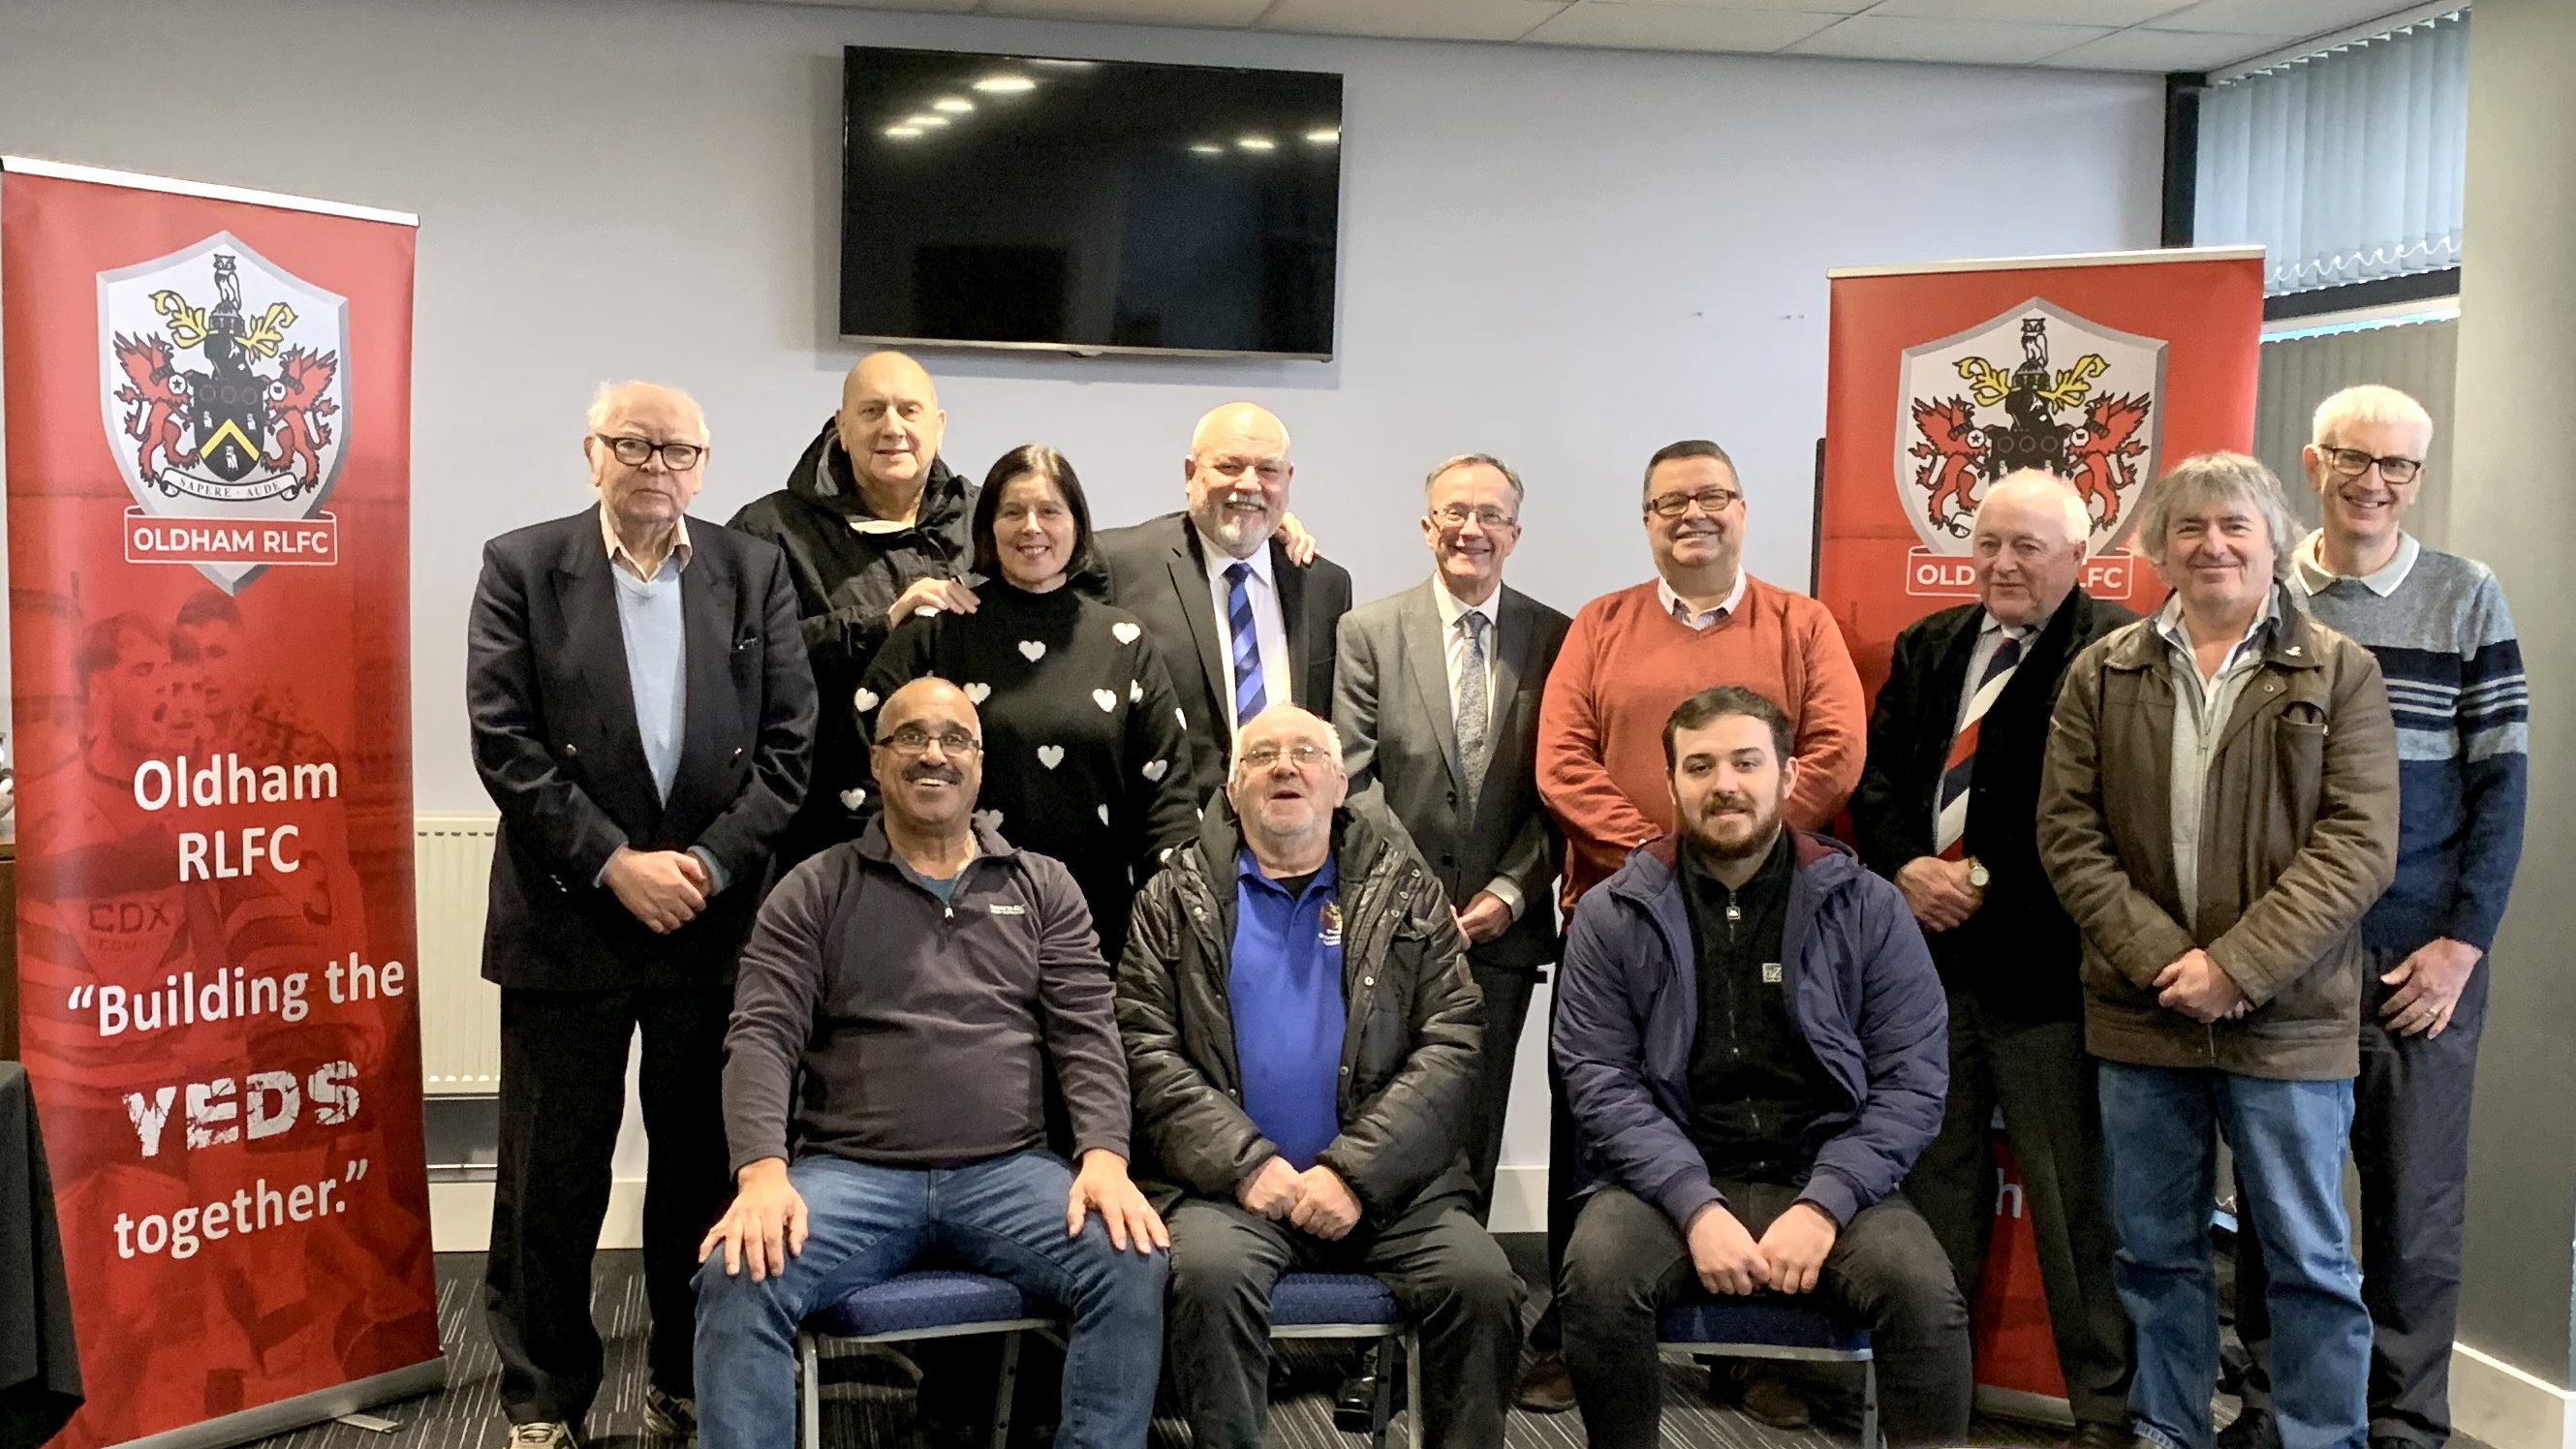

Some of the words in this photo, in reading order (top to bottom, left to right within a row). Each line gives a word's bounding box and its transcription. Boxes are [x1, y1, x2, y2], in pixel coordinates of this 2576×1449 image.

[179, 478, 232, 497] SAPERE
[246, 482, 281, 497] AUDE
[134, 527, 255, 552] OLDHAM
[264, 530, 328, 554] RLFC
[1916, 564, 1976, 586] OLD
[134, 753, 338, 812] Oldham
[178, 824, 300, 882] RLFC
[325, 951, 405, 1004] the
[121, 1061, 360, 1157] YEDS
